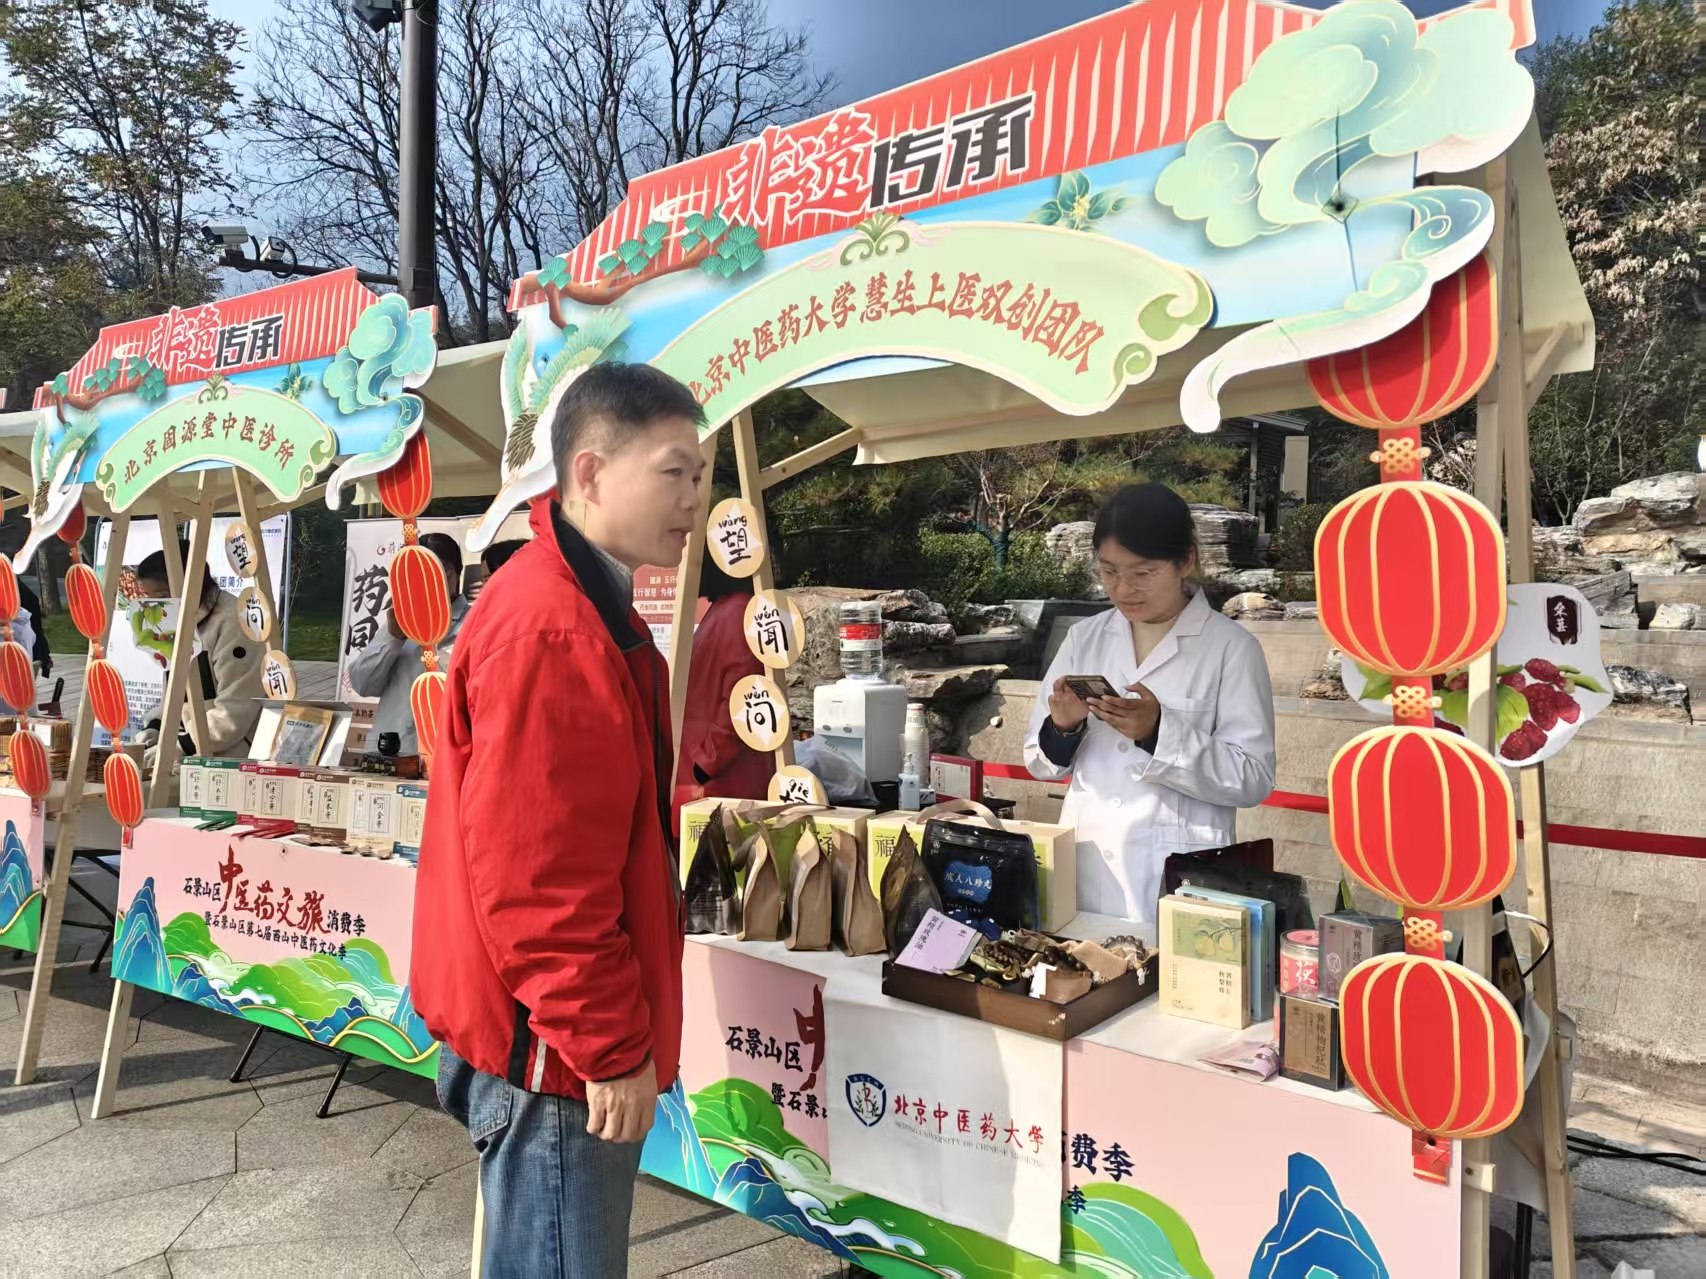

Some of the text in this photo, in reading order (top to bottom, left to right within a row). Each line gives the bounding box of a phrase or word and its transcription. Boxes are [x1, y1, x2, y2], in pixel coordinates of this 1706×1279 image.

[720, 92, 1034, 225] 非遗传承
[147, 305, 284, 371] 非遗传承
[233, 542, 251, 569] 望
[720, 528, 751, 565] 望
[246, 604, 264, 630] 问
[756, 620, 789, 655] 闻
[267, 671, 288, 697] 闻
[745, 700, 777, 733] 问
[875, 835, 896, 857] 福
[771, 1082, 828, 1119] 暨石景
[1061, 1130, 1135, 1182] 费季
